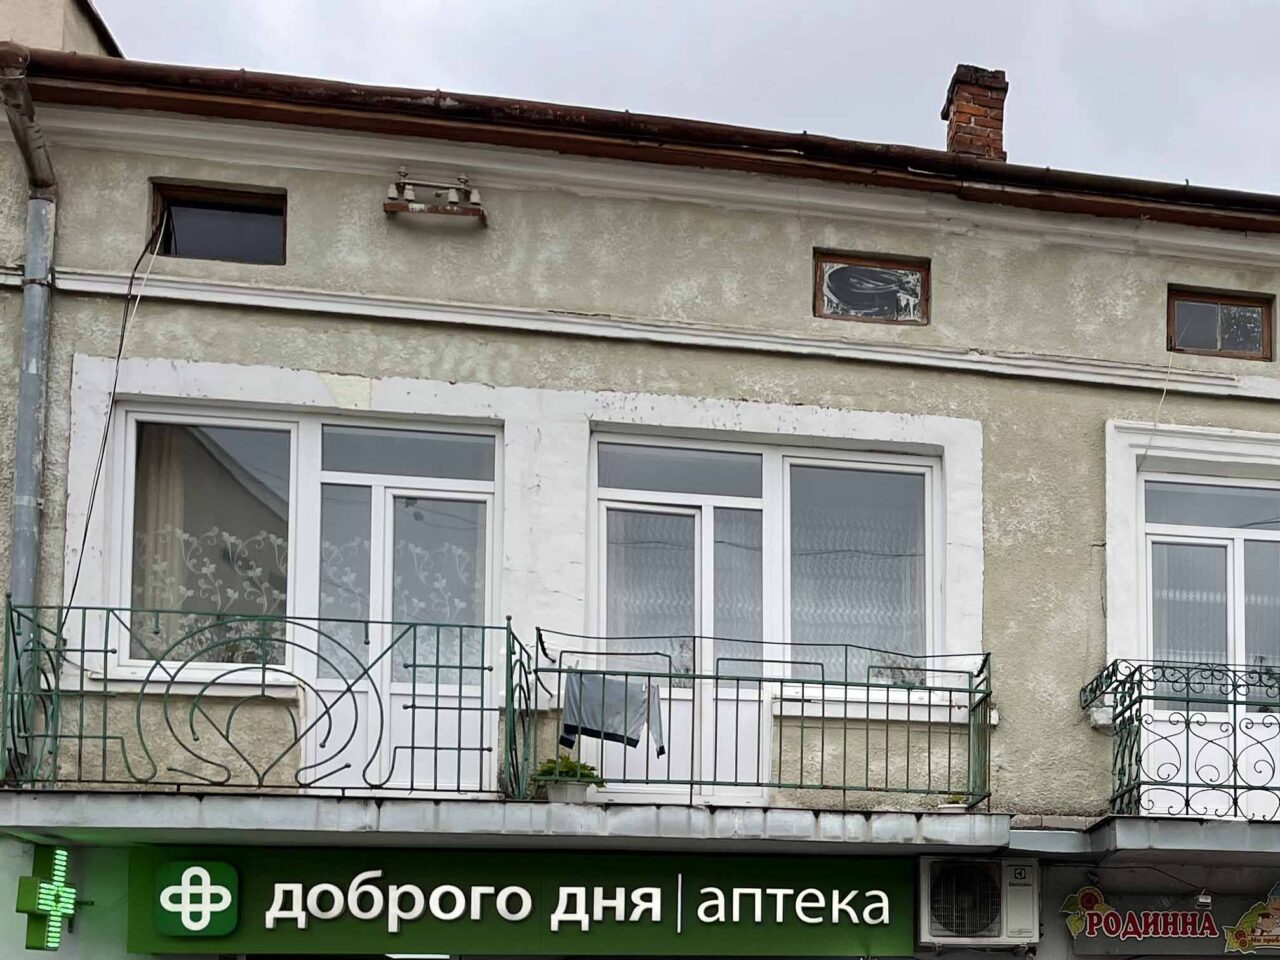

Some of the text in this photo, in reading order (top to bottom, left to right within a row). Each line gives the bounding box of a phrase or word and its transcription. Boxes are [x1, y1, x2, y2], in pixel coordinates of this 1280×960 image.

[265, 869, 891, 933] доброго дня аптека
[1085, 909, 1220, 940] РОДИННА
